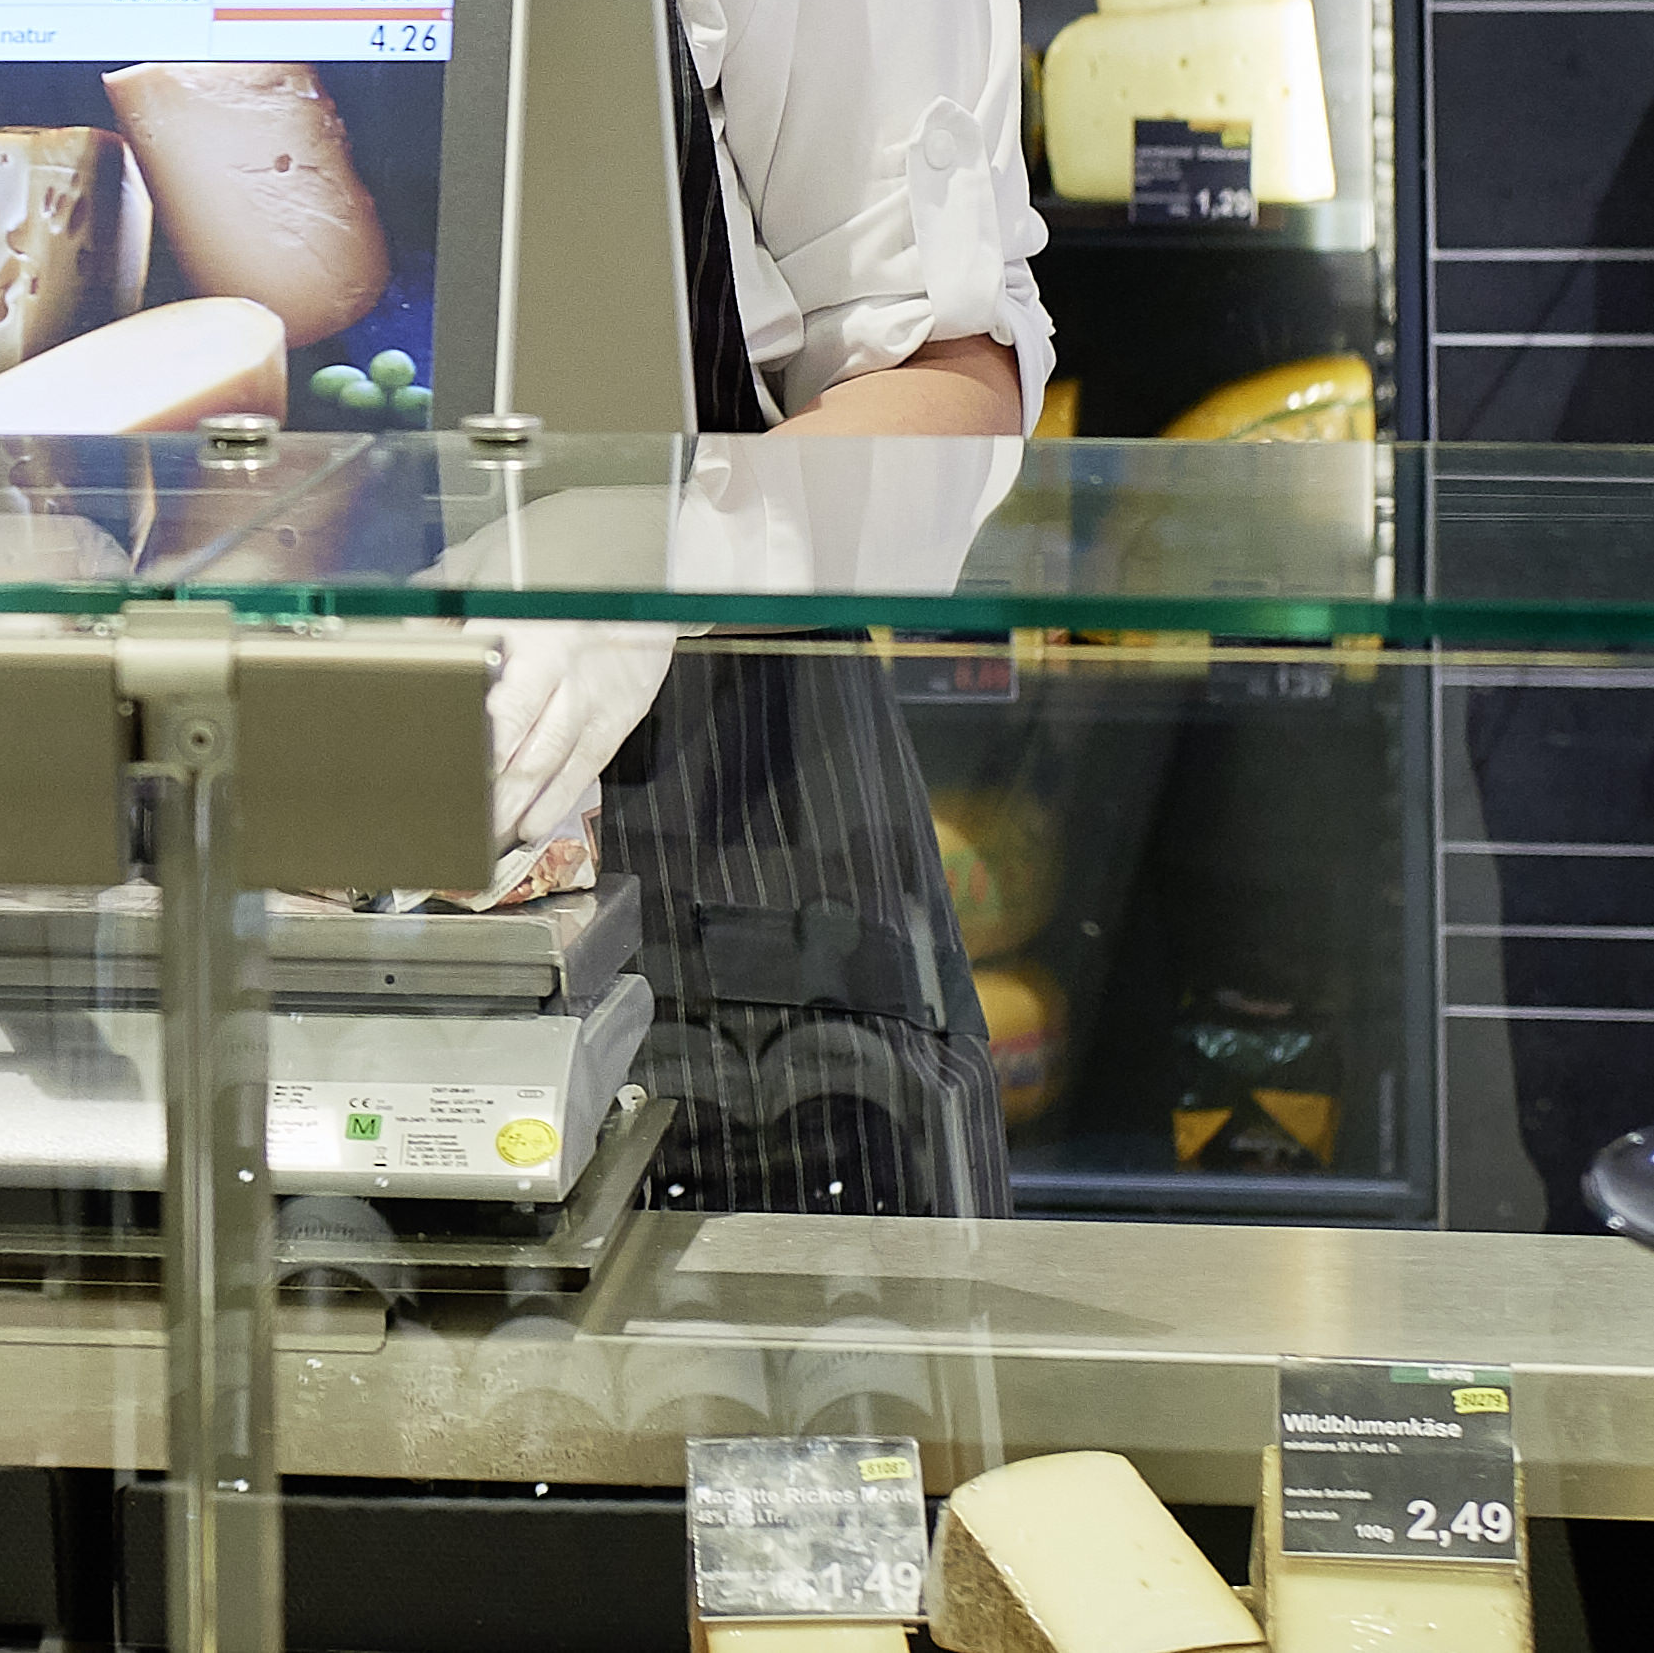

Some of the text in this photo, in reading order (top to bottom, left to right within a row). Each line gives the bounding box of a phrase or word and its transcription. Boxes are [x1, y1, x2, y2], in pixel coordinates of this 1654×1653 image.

[0, 28, 57, 44] natur
[370, 24, 437, 52] 4.26
[352, 1117, 377, 1135] M
[1282, 1413, 1464, 1439] Wildblumenkäse
[695, 1487, 779, 1506] Ractte
[785, 1486, 857, 1505] Riches
[1354, 1523, 1395, 1544] 100g
[1406, 1499, 1513, 1548] 2,49
[822, 1561, 922, 1605] 1,49
